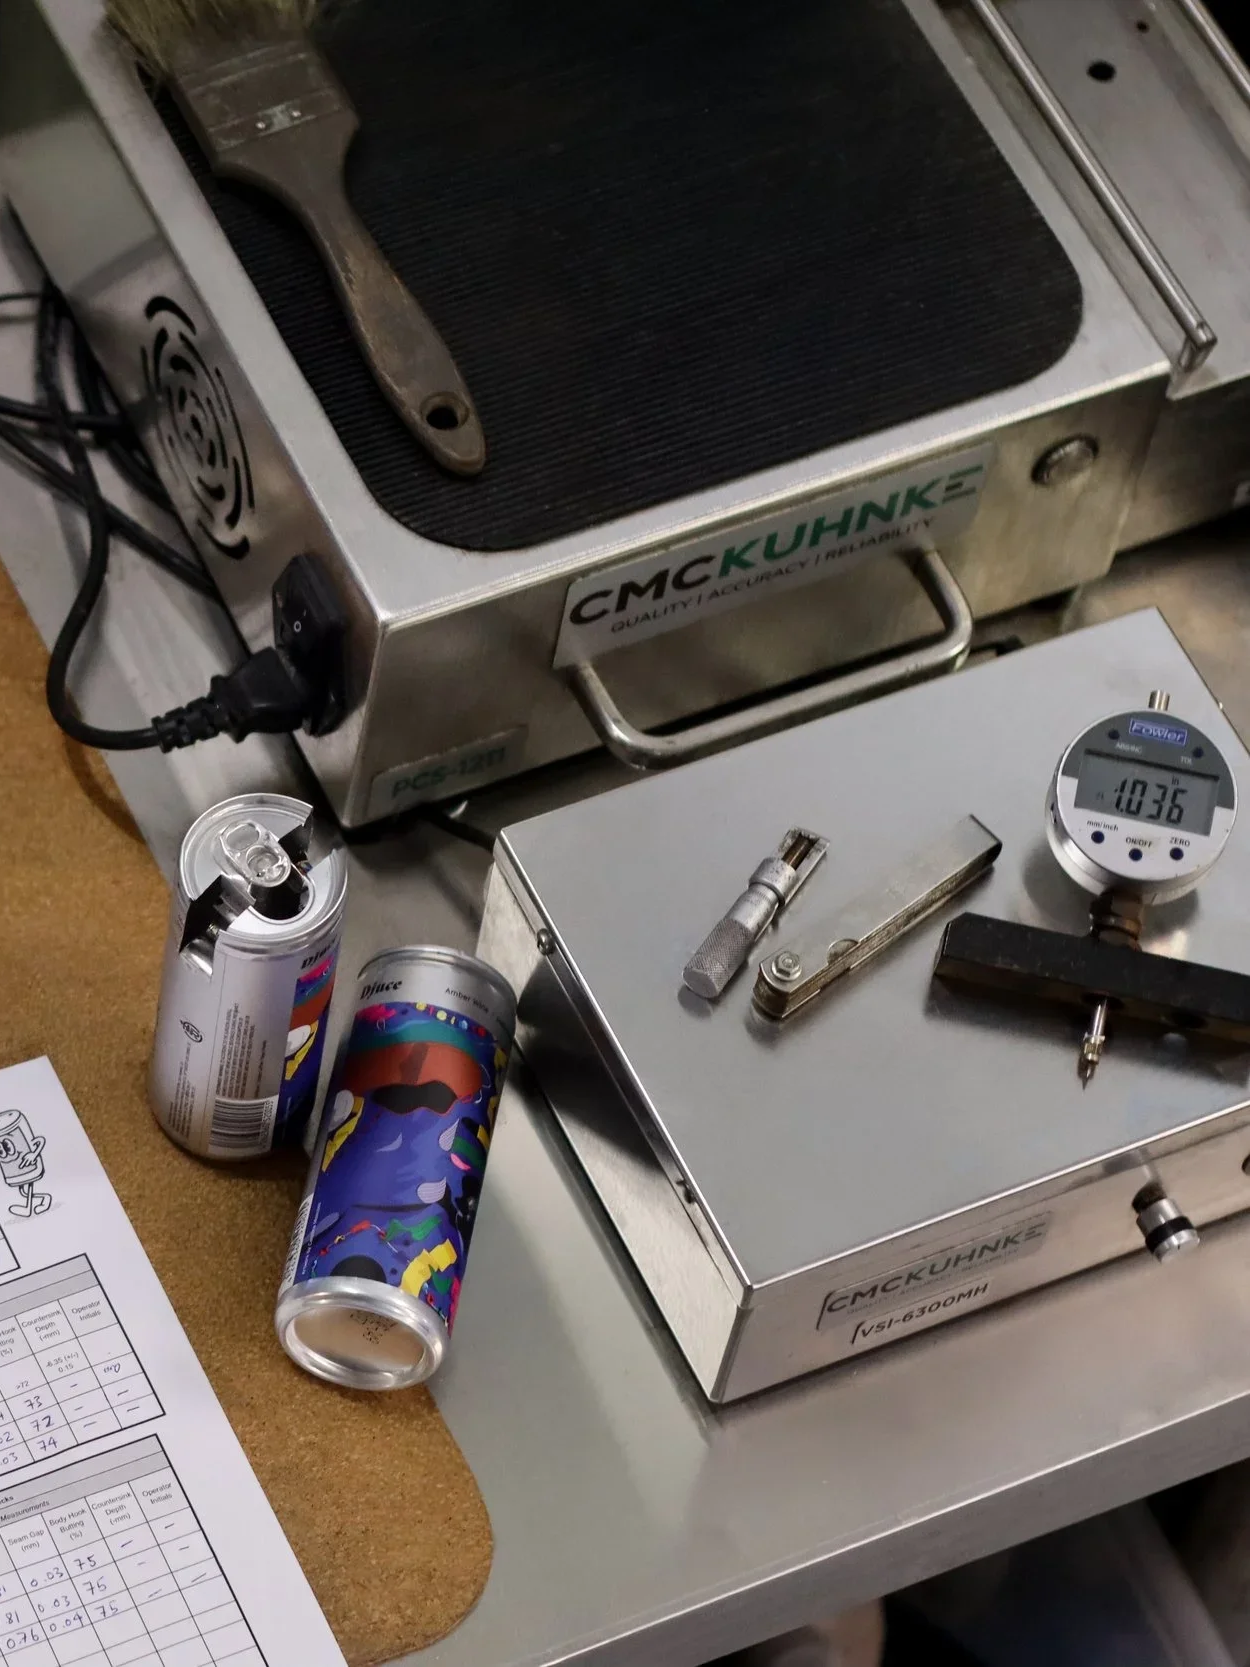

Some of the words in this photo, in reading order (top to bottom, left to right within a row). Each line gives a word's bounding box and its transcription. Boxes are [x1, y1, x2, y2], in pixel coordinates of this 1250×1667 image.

[610, 599, 693, 633] QUALITY
[709, 560, 807, 599] ACCURACY
[823, 516, 937, 562] RELIABILITY
[1131, 721, 1183, 742] Fowler
[1172, 776, 1179, 786] in
[1170, 837, 1190, 847] ZERO
[360, 980, 402, 999] Djuce
[21, 1309, 62, 1328] Countersink
[861, 1283, 989, 1337] VSI-6300MH
[35, 1321, 56, 1333] Depth
[32, 1415, 54, 1432] 72
[74, 1555, 97, 1571] 75
